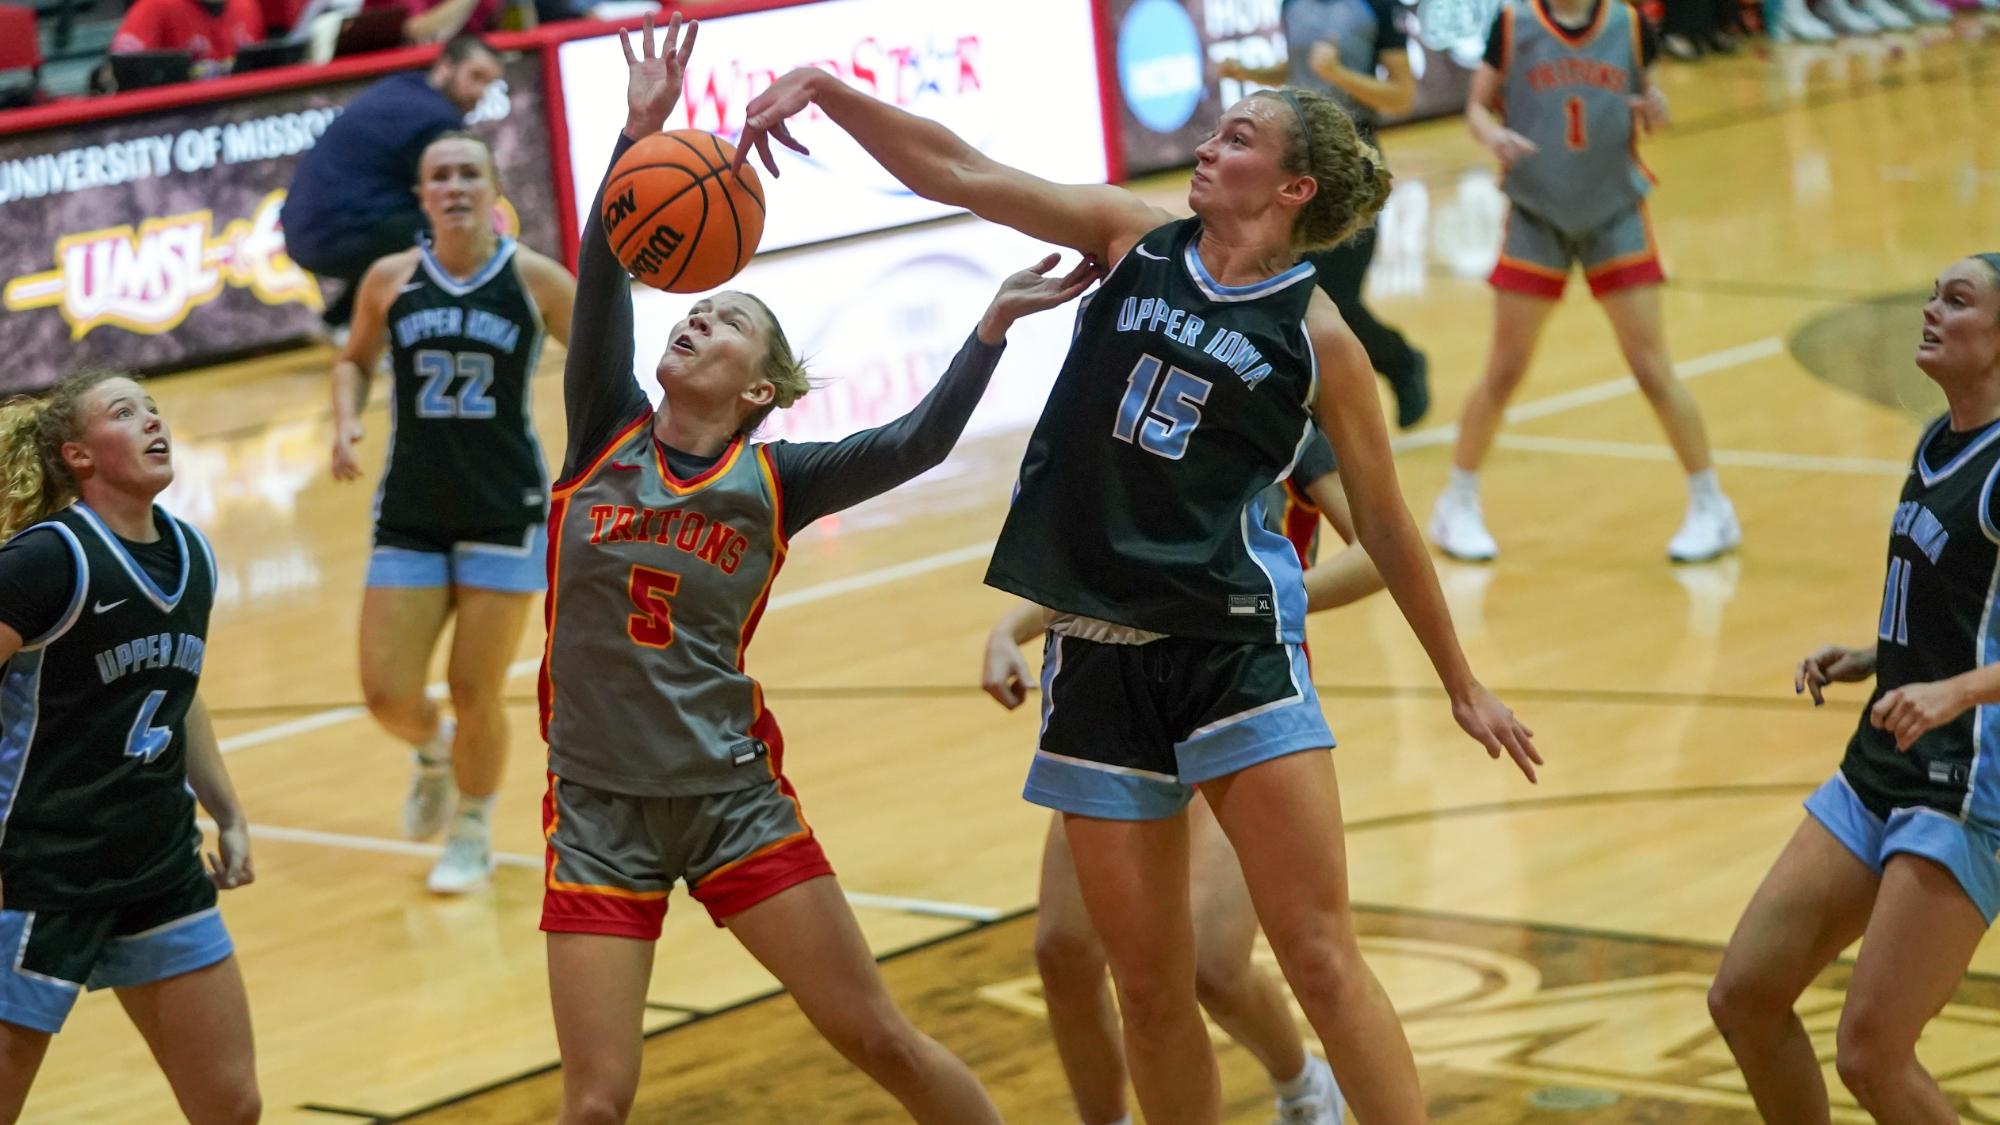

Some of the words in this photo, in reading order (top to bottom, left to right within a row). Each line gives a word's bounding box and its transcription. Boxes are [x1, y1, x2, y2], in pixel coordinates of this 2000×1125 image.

[1563, 96, 1589, 151] 1
[0, 134, 173, 202] UNIVERSITY
[174, 126, 222, 172] OF
[63, 222, 220, 320] UMSL
[394, 306, 463, 349] UPPER
[463, 308, 521, 354] IOWA
[1116, 297, 1204, 348] UPPER
[1203, 327, 1273, 392] IOWA
[413, 349, 497, 419] 22
[1112, 352, 1214, 461] 15
[589, 504, 749, 576] TRITONS
[627, 564, 681, 649] 5
[1259, 600, 1271, 610] XL
[1878, 555, 1913, 647] 11
[95, 632, 173, 685] UPPER
[172, 632, 206, 676] IOW
[124, 690, 174, 765] 4
[755, 743, 765, 753] M
